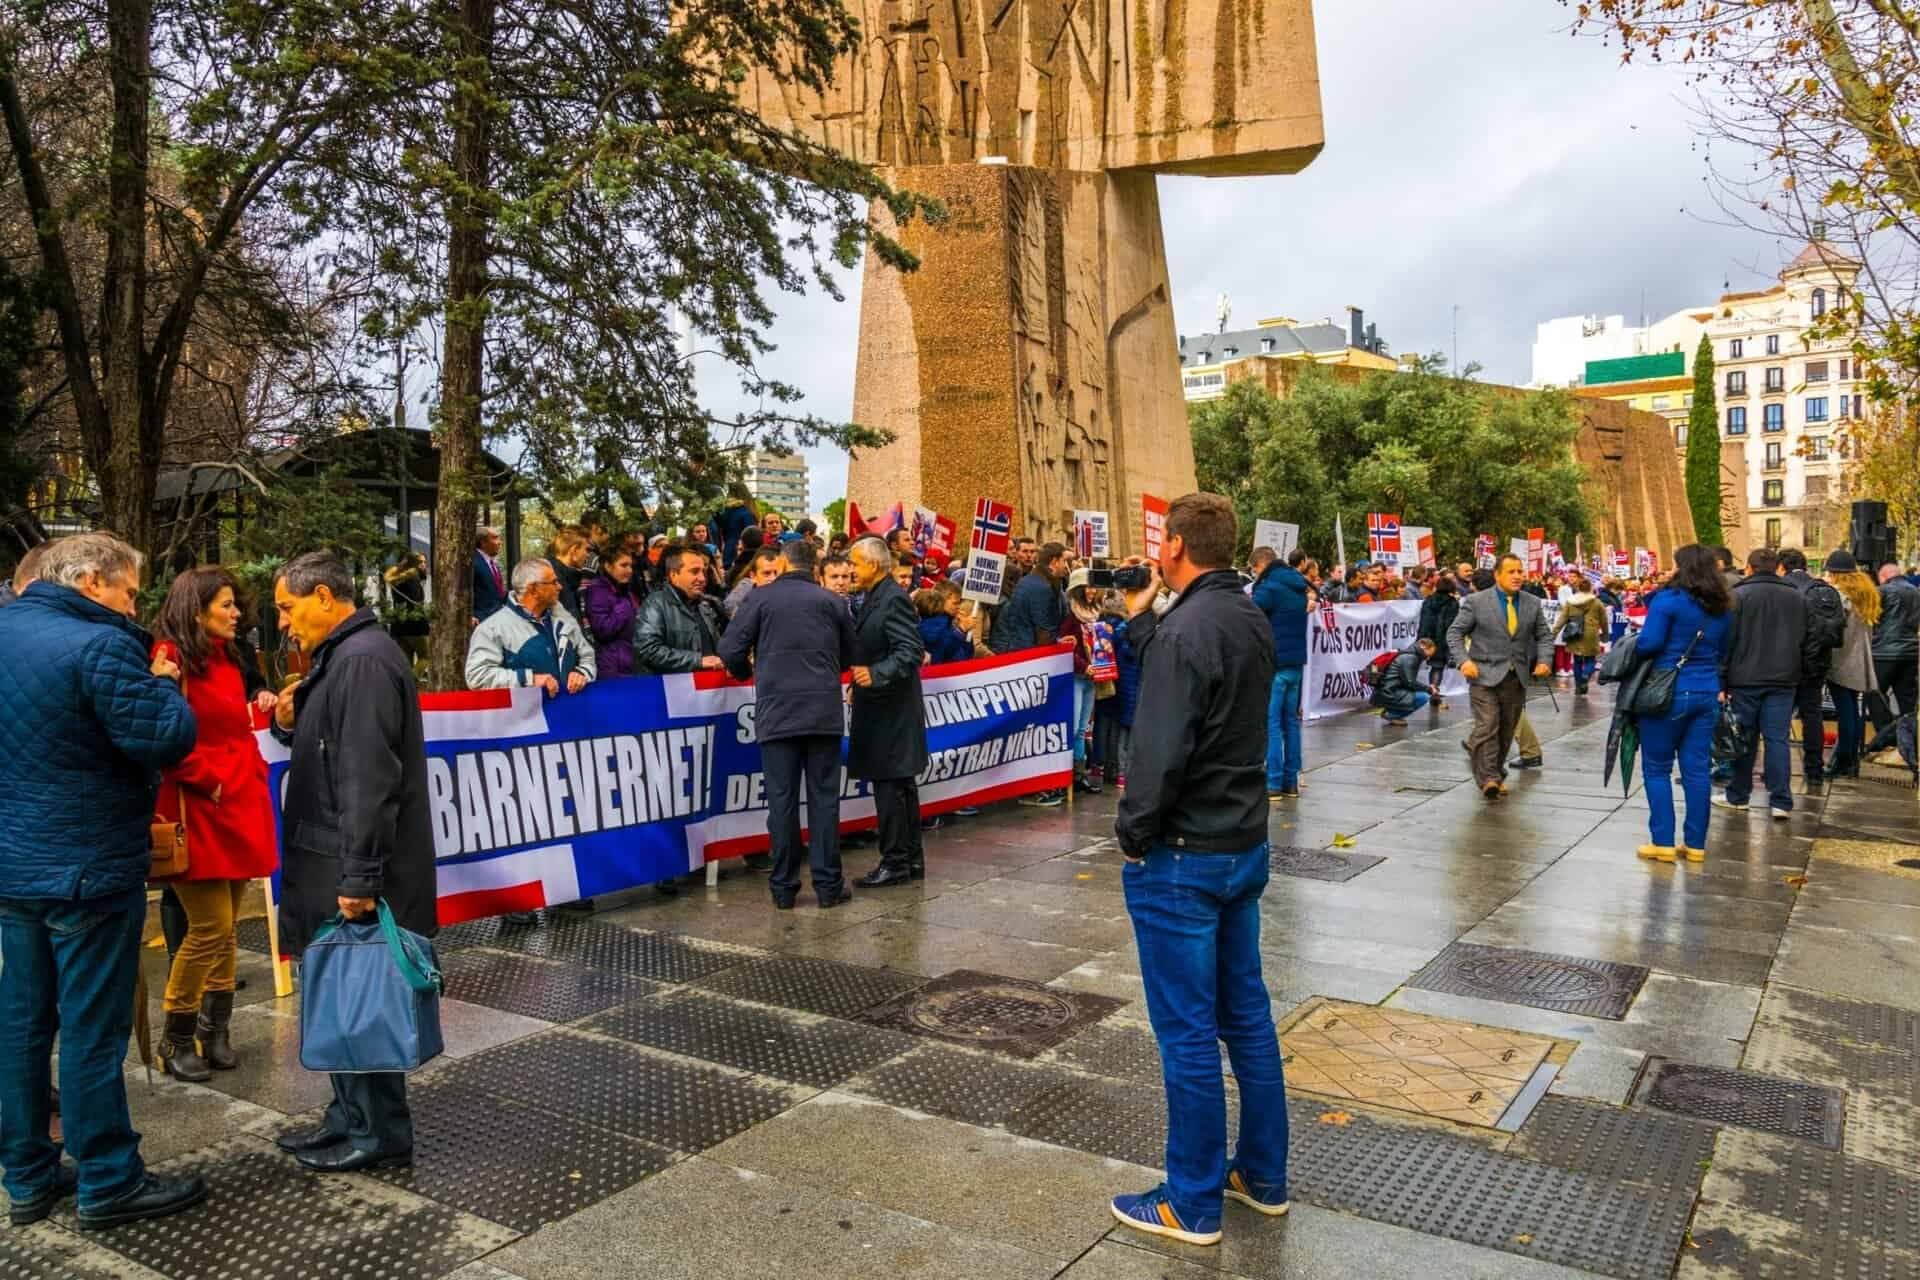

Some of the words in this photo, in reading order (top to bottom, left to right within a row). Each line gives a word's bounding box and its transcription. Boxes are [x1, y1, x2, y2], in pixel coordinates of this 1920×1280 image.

[1345, 623, 1388, 652] SOMOS
[923, 673, 1049, 728] DNAPPING!
[1002, 722, 1069, 763] NIÑOS!
[426, 725, 716, 859] BARNEVERNET!
